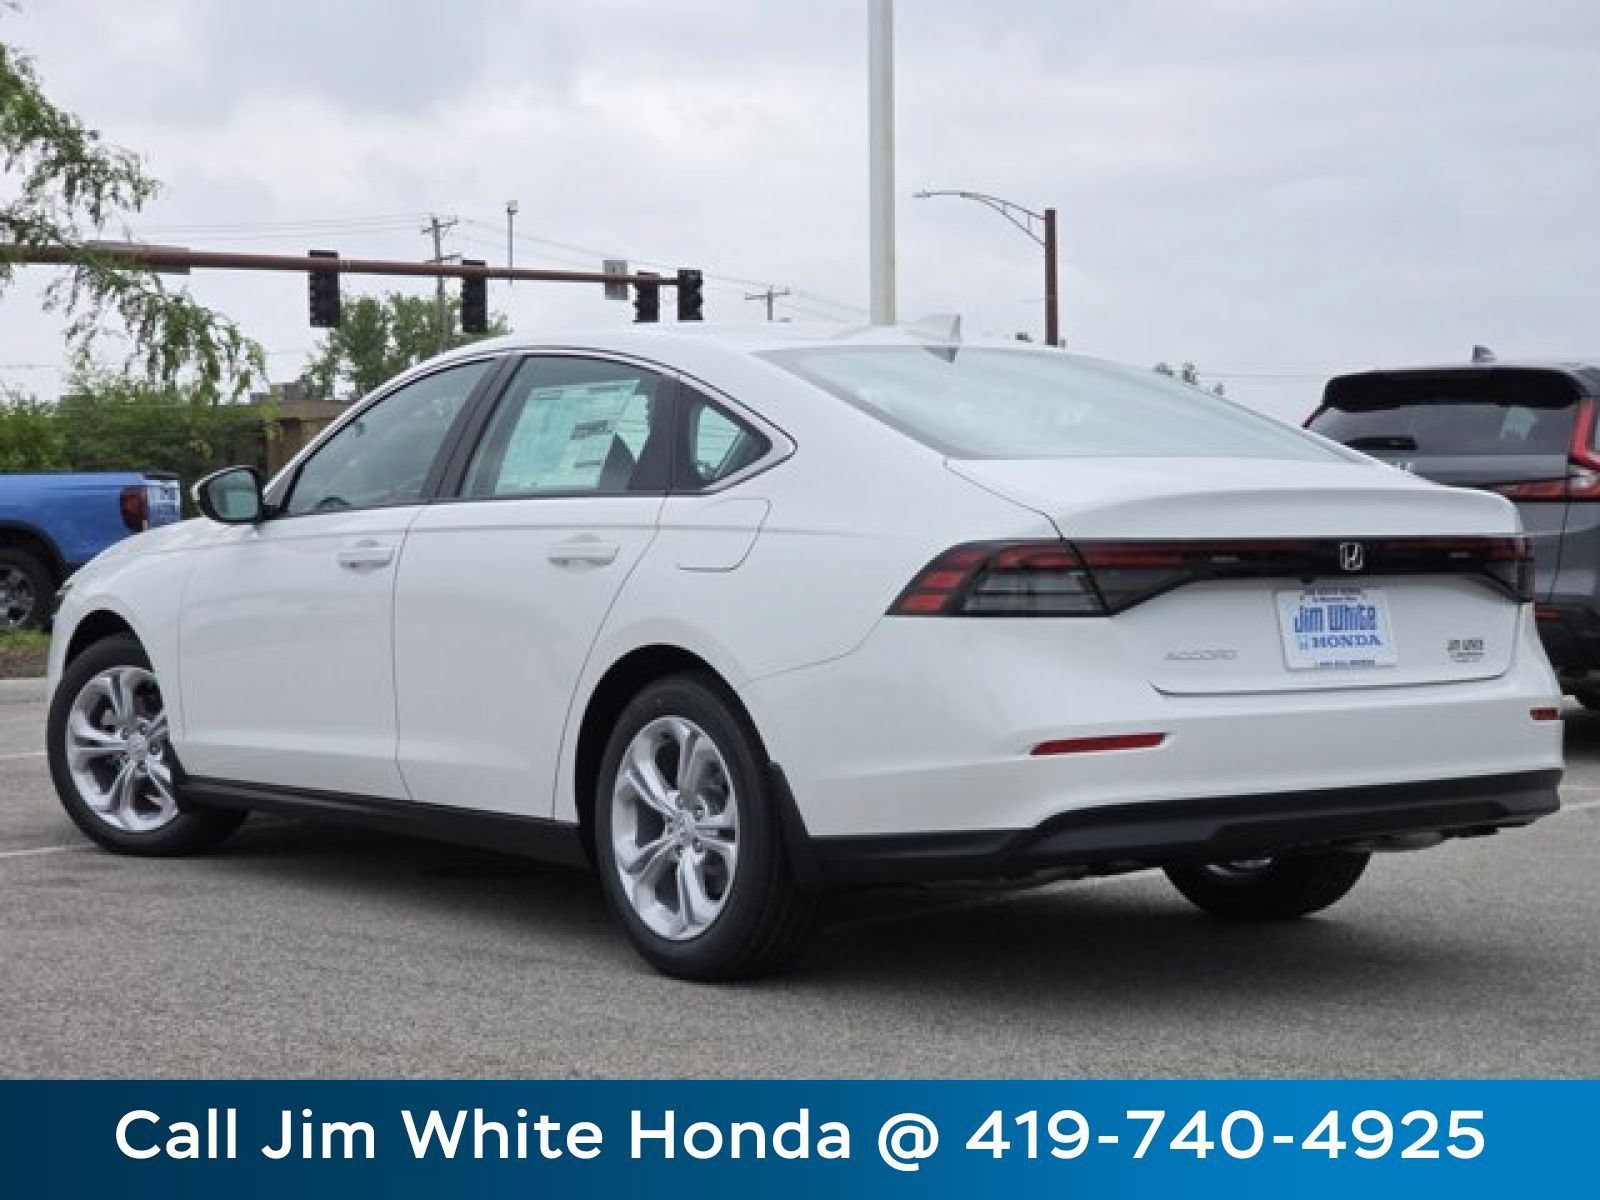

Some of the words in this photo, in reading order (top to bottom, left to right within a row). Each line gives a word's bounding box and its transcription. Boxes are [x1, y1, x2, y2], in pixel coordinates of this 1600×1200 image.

[1294, 605, 1323, 633] Jim
[1327, 604, 1376, 631] White
[1312, 634, 1382, 649] HONDA
